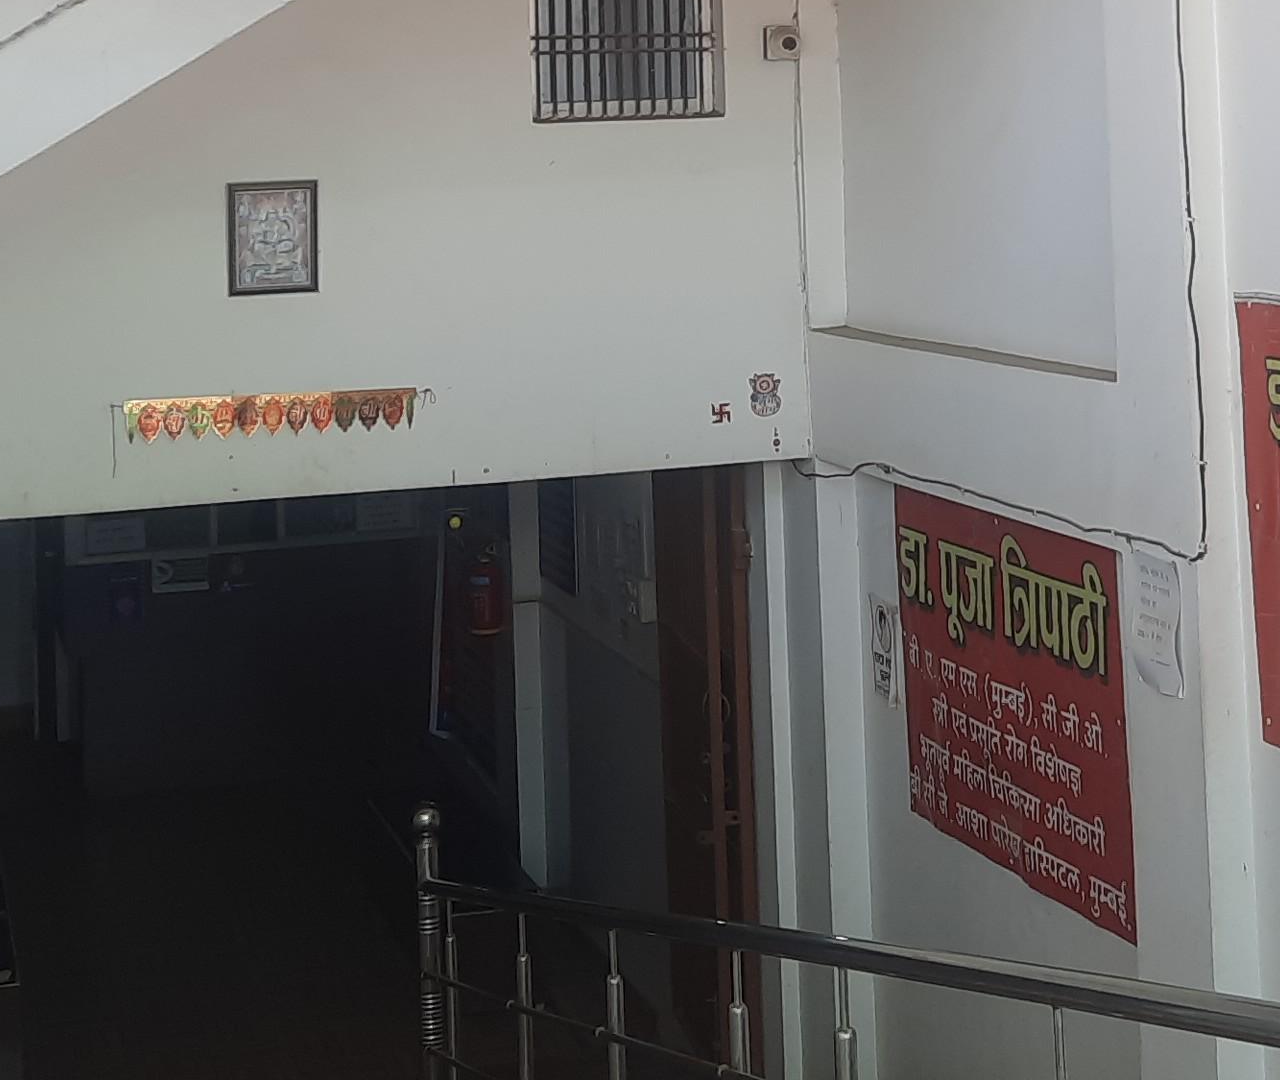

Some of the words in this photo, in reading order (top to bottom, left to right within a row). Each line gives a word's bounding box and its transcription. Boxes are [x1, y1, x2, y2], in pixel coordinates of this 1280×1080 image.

[898, 526, 934, 606] डा.
[937, 539, 995, 645] पूजा
[1000, 533, 1108, 677] त्रिपाठी
